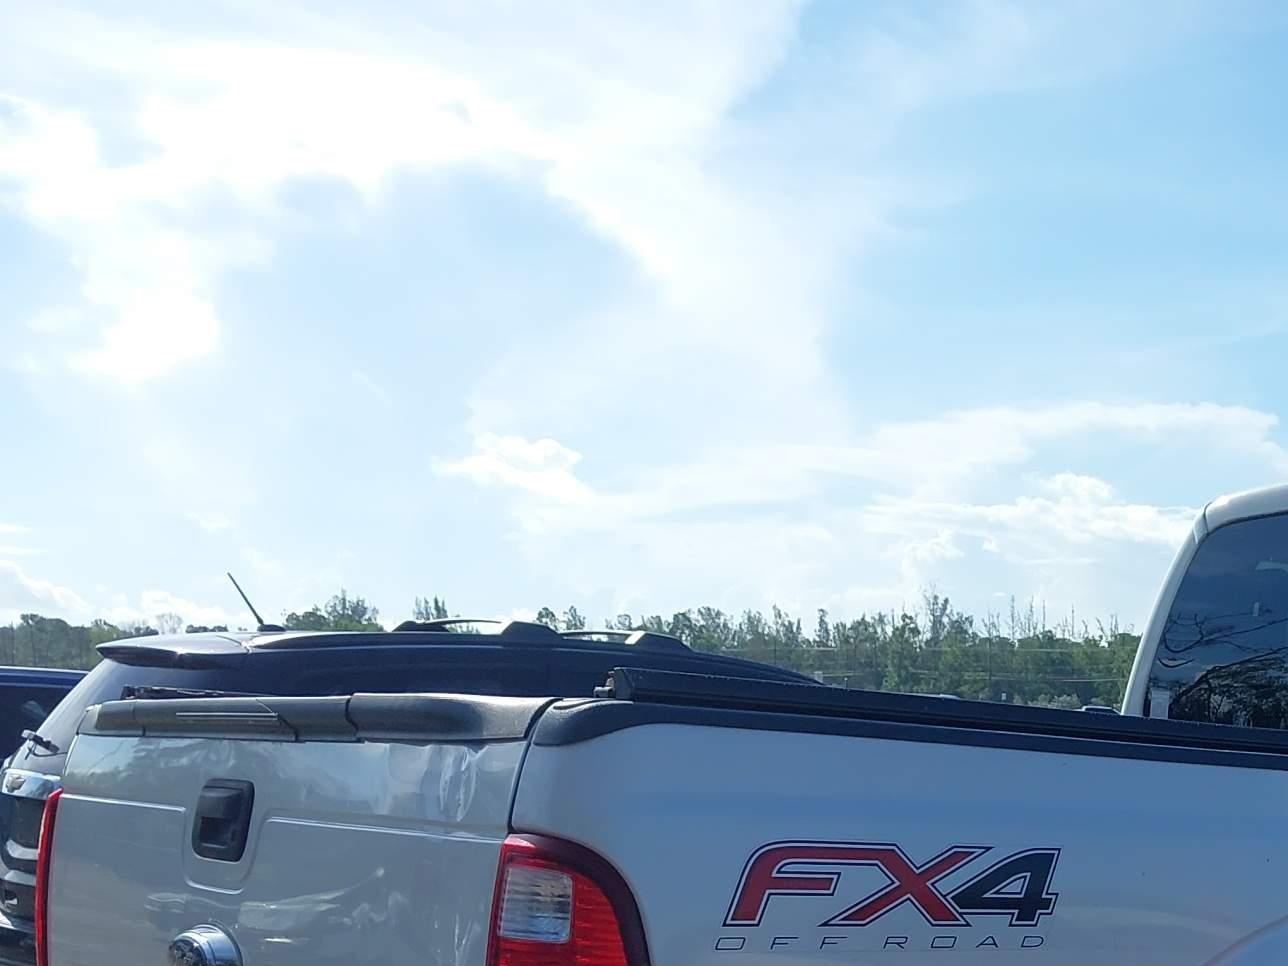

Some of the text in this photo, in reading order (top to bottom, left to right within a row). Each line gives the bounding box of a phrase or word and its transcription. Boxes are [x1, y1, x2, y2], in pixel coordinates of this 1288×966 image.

[721, 838, 1063, 929] FX4
[714, 935, 1046, 951] OFF ROAD
